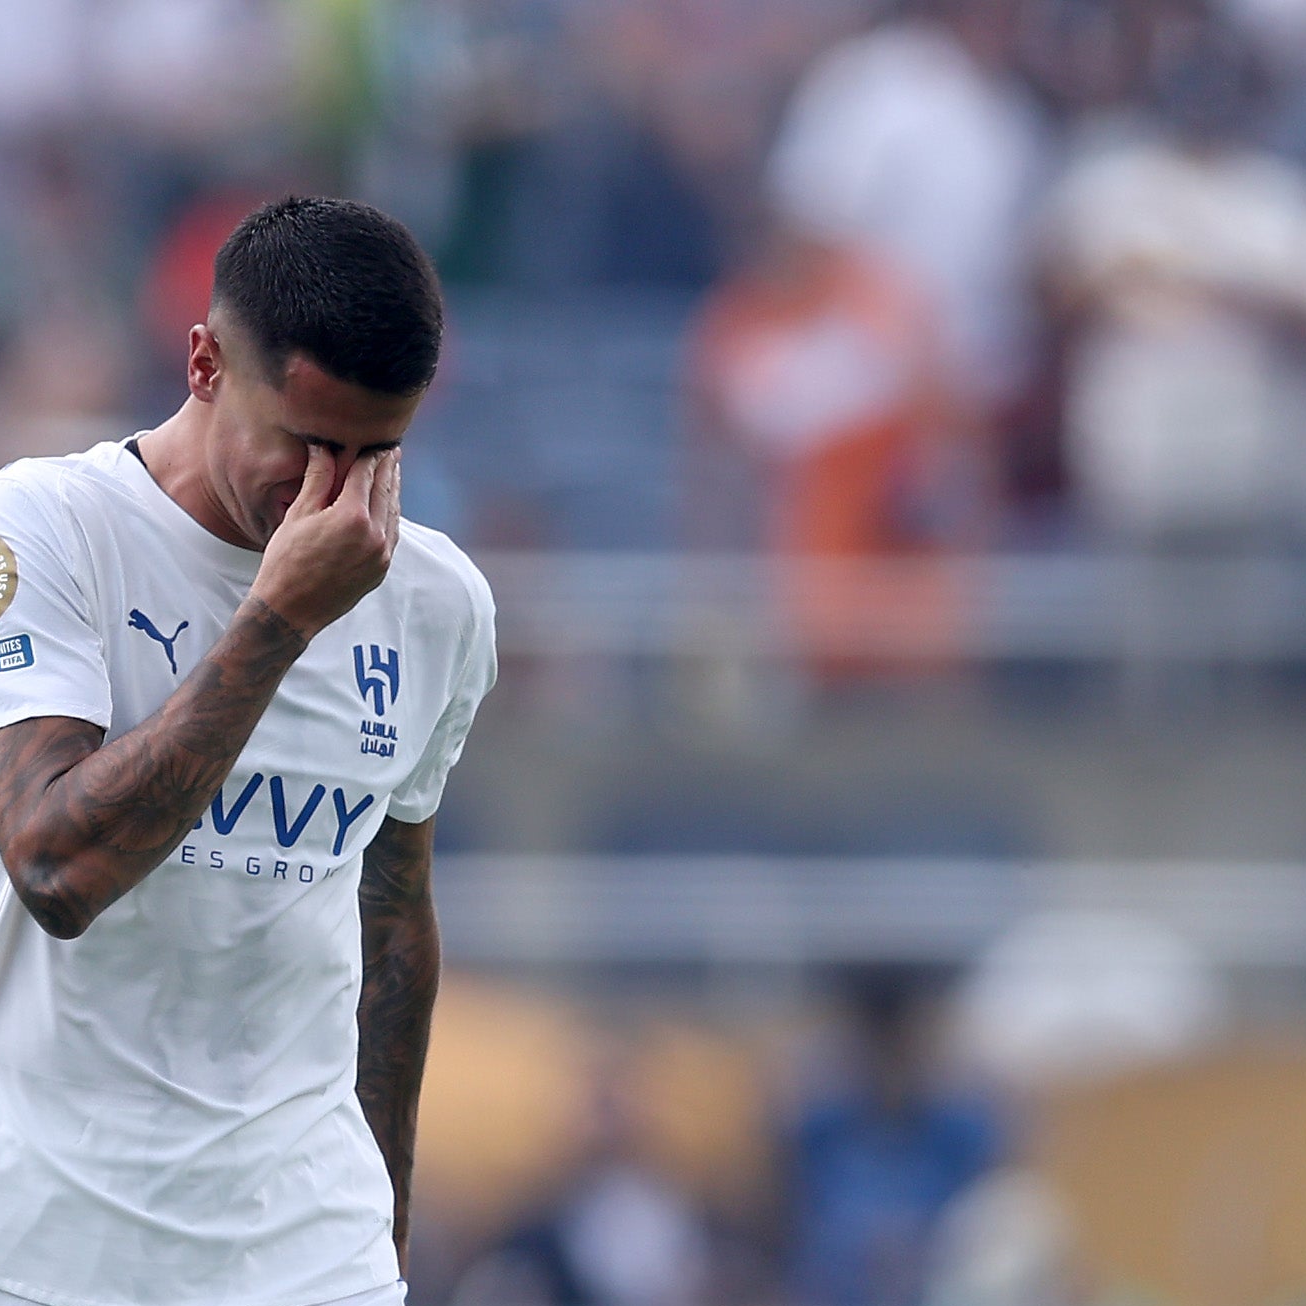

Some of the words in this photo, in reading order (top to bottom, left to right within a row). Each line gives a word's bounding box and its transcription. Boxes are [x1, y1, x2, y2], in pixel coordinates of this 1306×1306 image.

[2, 655, 23, 666] FIFA
[360, 719, 398, 741] ALHILAL
[360, 737, 396, 758] الهلال
[191, 772, 375, 857] VVY
[245, 857, 339, 883] GRO
